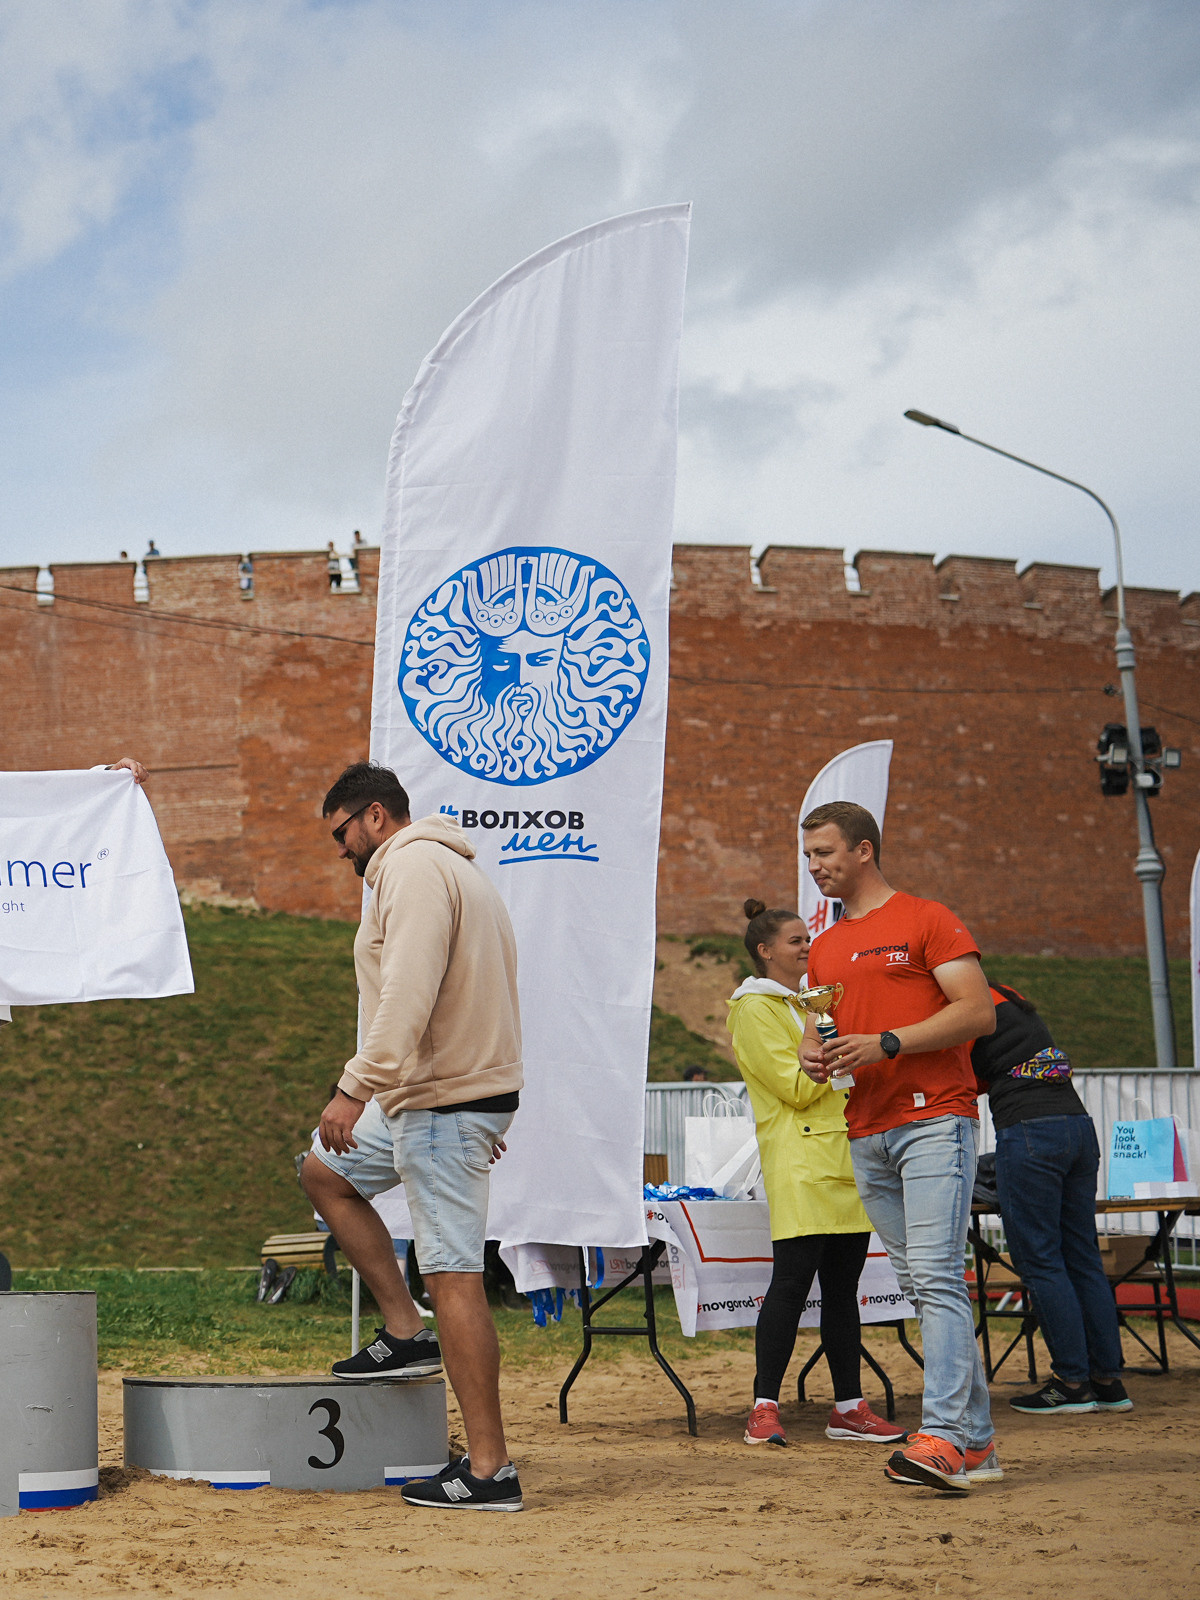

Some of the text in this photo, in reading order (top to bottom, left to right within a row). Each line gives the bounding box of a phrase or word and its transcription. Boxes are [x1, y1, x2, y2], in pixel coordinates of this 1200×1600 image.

[851, 942, 909, 962] #novgorod
[1116, 1126, 1135, 1135] You
[1115, 1134, 1136, 1143] look
[1114, 1142, 1133, 1151] like
[1113, 1150, 1147, 1159] snack!
[860, 1293, 905, 1306] #novgor
[308, 1398, 345, 1470] 3
